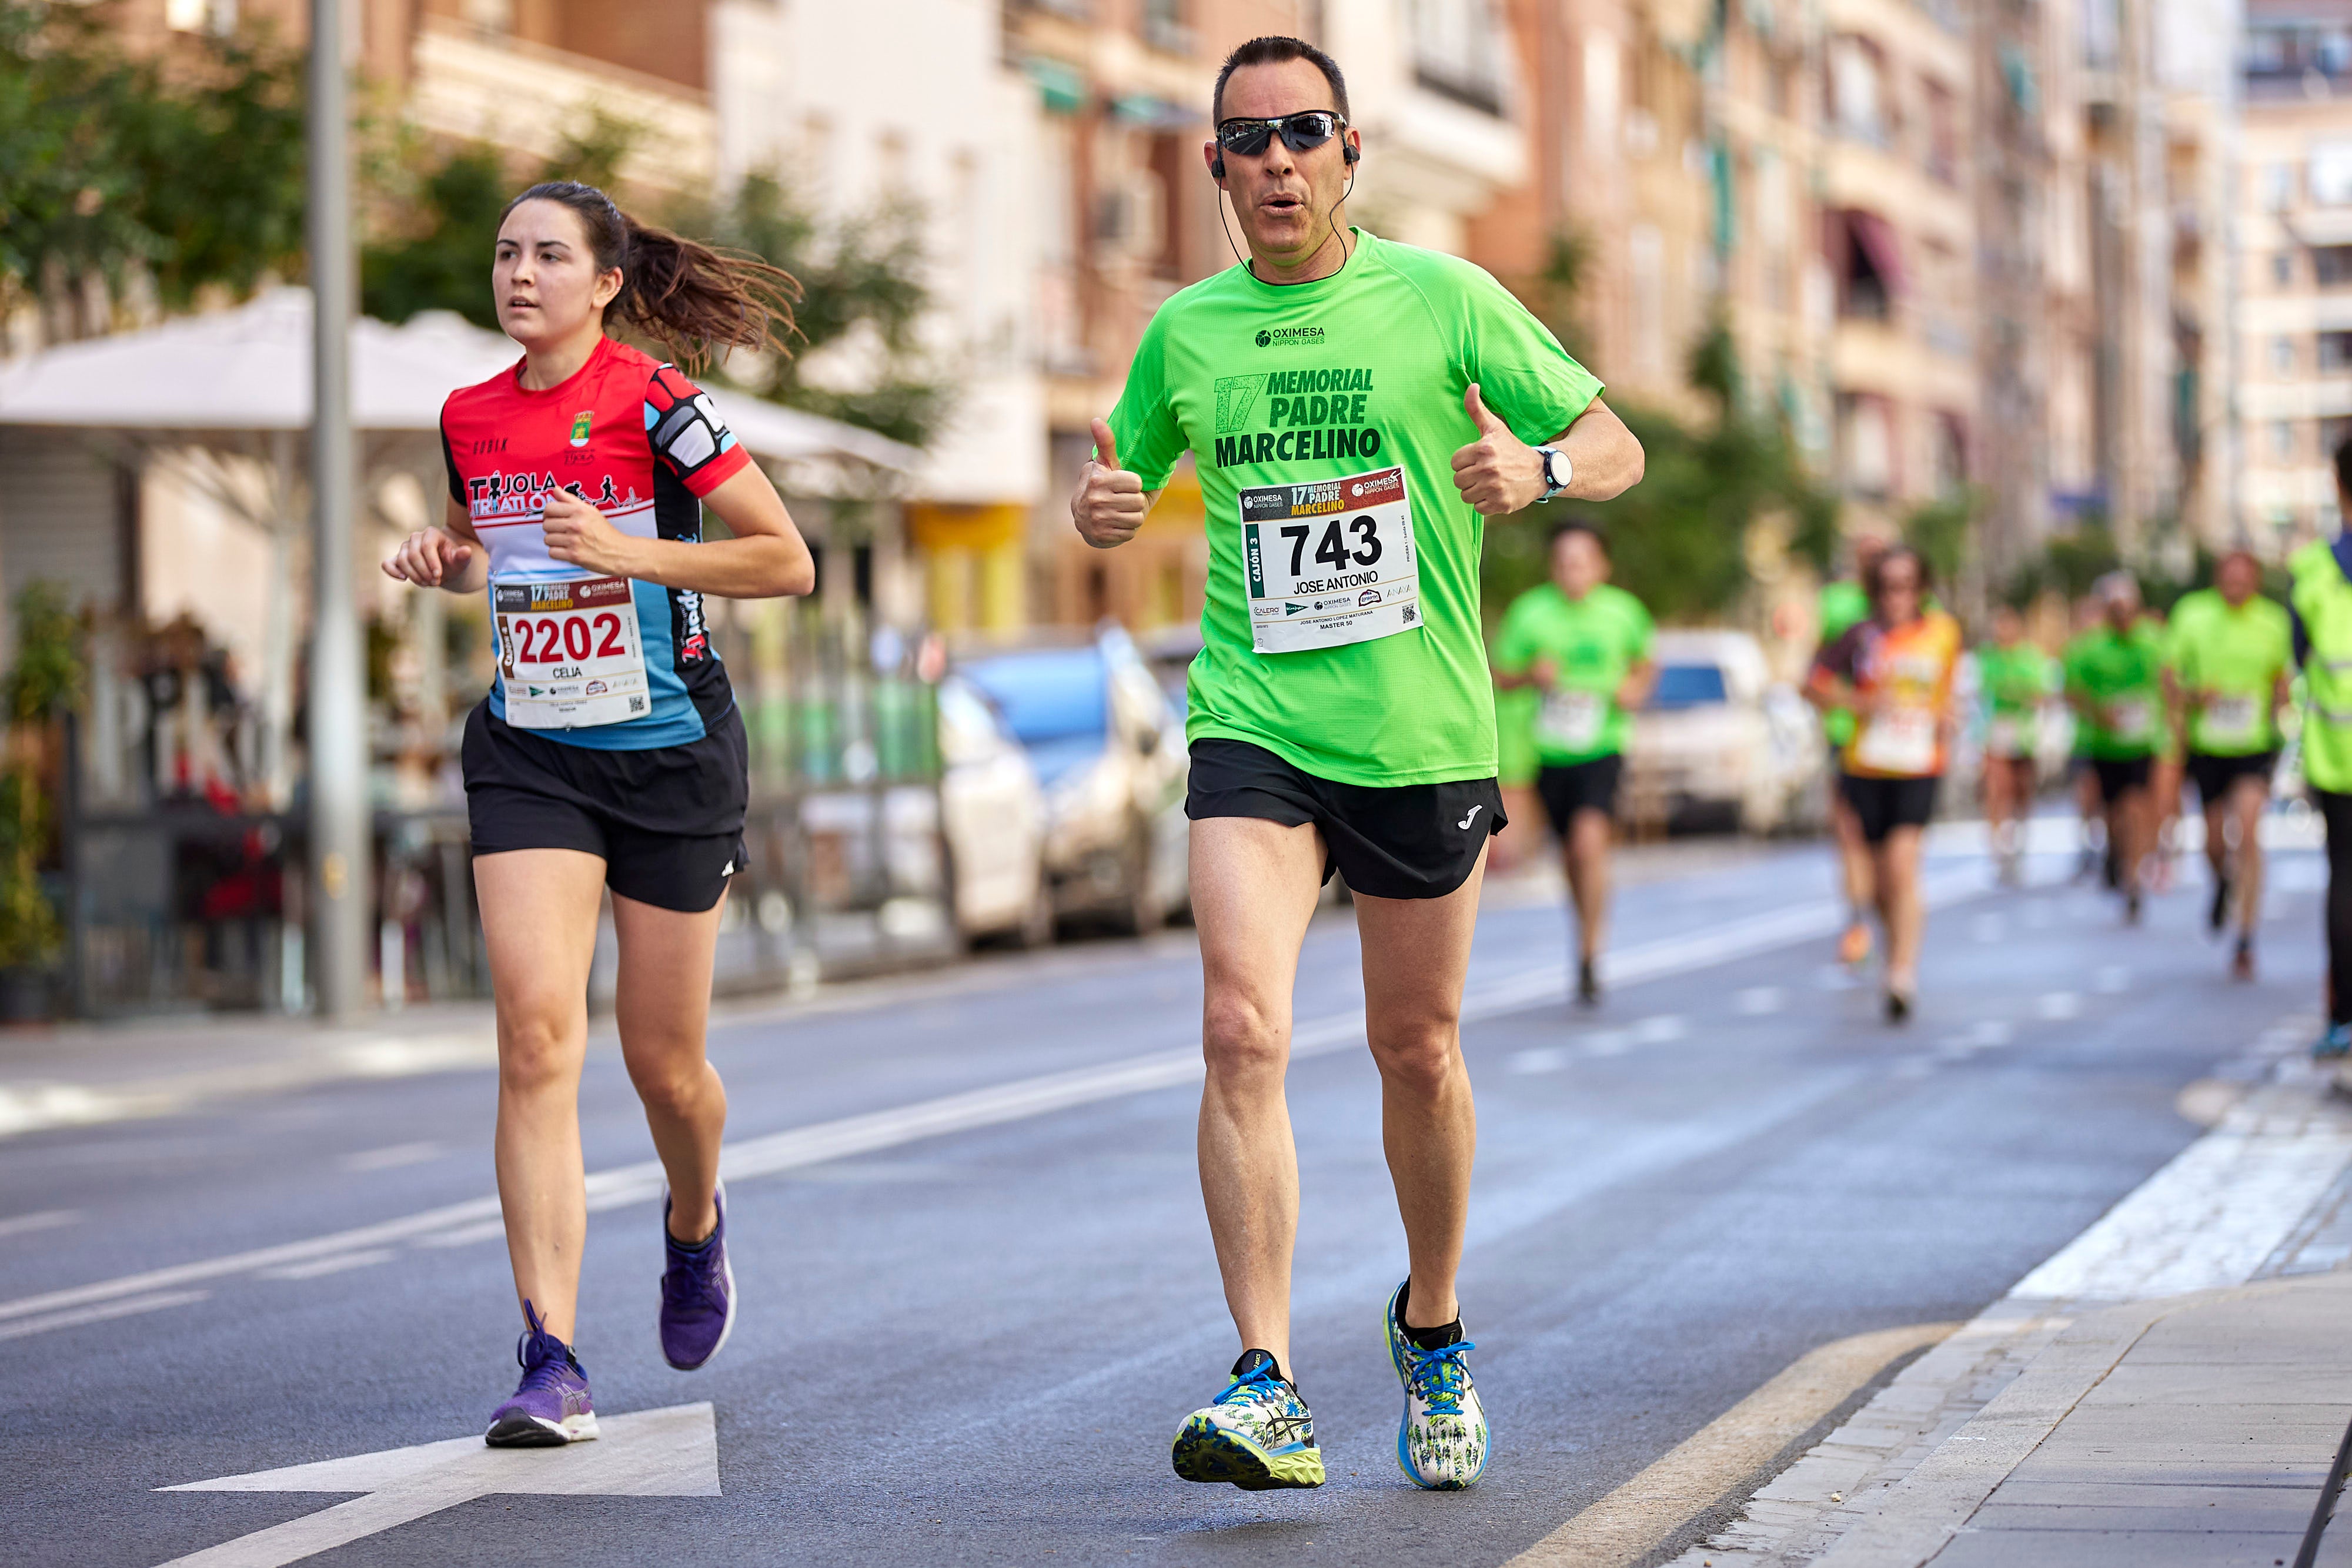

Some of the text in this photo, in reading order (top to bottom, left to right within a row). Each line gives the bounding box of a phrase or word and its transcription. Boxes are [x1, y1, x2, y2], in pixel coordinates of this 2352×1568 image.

[1273, 327, 1325, 338] OXIMESA
[1266, 369, 1374, 395] MEMORIAL
[1214, 373, 1268, 434] 17
[1269, 394, 1367, 428] PADRE
[1215, 428, 1381, 468] MARCELINO
[1307, 482, 1341, 493] MEMORIAL
[1364, 477, 1399, 489] OXIMESA
[1253, 494, 1282, 503] OXIMESA
[1291, 486, 1308, 505] 17
[1309, 490, 1339, 504] PADRE
[1291, 499, 1345, 516] MARCELINO
[1280, 515, 1382, 576] 743
[1250, 548, 1261, 582] CAJÓN
[1294, 570, 1378, 594] JOSE ANTONIO
[530, 584, 543, 601] 17
[1324, 597, 1351, 606] OXIMESA
[515, 612, 625, 663] 2202
[553, 666, 583, 678] CELIA
